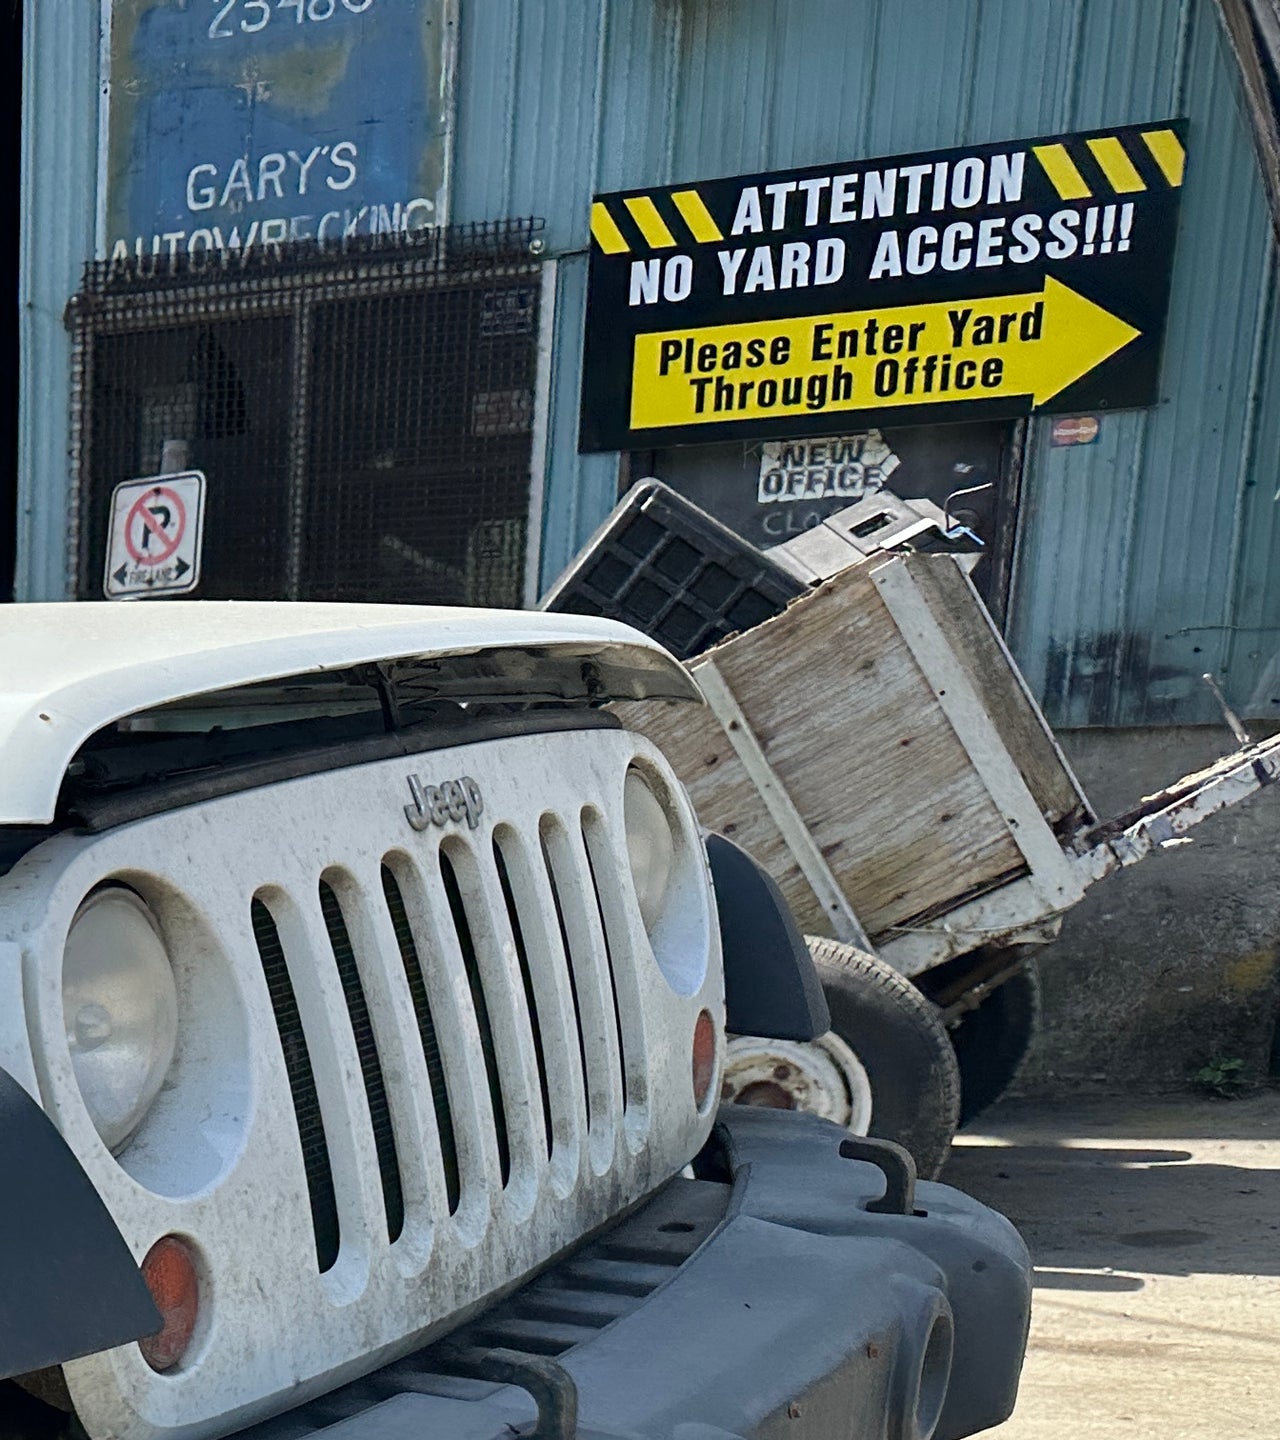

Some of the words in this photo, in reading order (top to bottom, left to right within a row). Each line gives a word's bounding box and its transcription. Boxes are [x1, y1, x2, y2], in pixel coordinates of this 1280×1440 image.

[186, 141, 358, 211] GARY'S
[731, 151, 1027, 236] ATTENTION
[628, 254, 693, 307] NO
[718, 237, 847, 297] YARD
[868, 202, 1137, 280] ACCESS!!!
[658, 336, 791, 377] Please
[811, 317, 927, 361] Enter
[948, 301, 1043, 346] Yard
[689, 364, 852, 414] Through
[873, 354, 1003, 400] Office
[762, 464, 883, 496] OFFICE
[781, 435, 865, 468] NEW
[403, 773, 484, 832] Jeep
